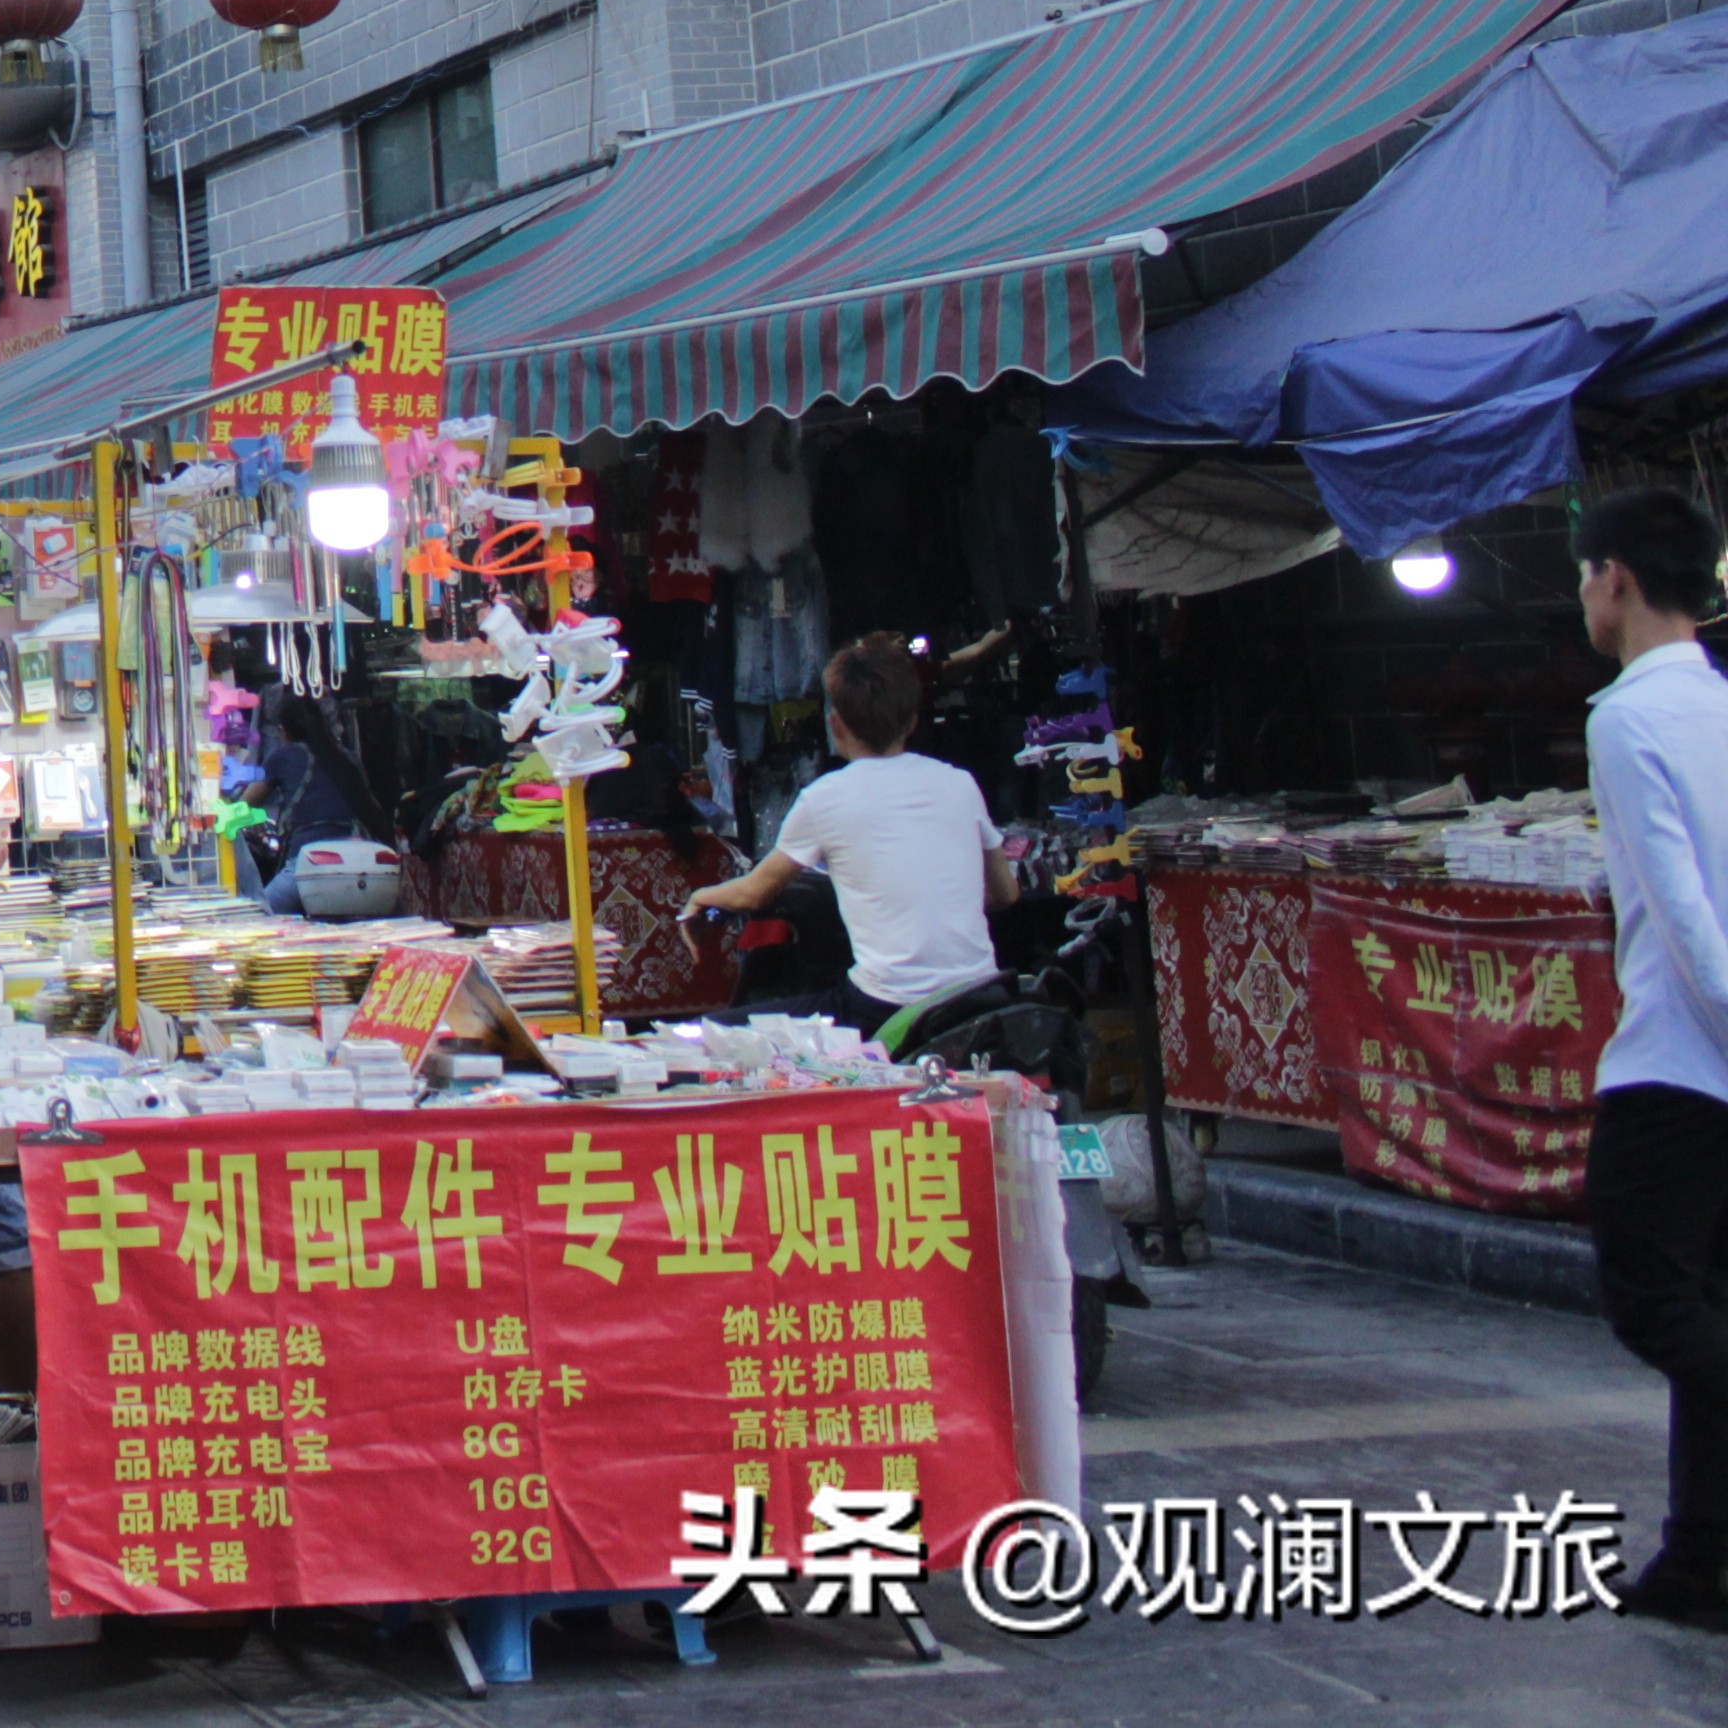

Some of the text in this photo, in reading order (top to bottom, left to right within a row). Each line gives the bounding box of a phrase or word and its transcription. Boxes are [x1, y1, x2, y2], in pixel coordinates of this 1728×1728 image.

[217, 297, 444, 377] 专业贴膜
[368, 392, 439, 418] 手机壳
[363, 962, 453, 1033] 专业贴膜
[1351, 931, 1583, 1032] 专业贴膜
[57, 1123, 972, 1305] 手机配件 专业贴膜
[455, 1313, 530, 1357] U盘
[722, 1297, 927, 1347] 纳米防爆膜
[109, 1324, 327, 1375] 品牌数据线
[725, 1349, 932, 1399] 蓝光护眼膜
[110, 1378, 327, 1428] 品牌充电头
[463, 1362, 586, 1409] 内存卡
[462, 1424, 520, 1461] 8G
[729, 1401, 939, 1450] 高清耐刮膜
[114, 1430, 332, 1481] 品牌充电宝
[117, 1485, 293, 1535] 品牌耳机
[468, 1475, 549, 1513] 16G
[118, 1540, 249, 1589] 读卡器
[469, 1527, 553, 1567] 32G
